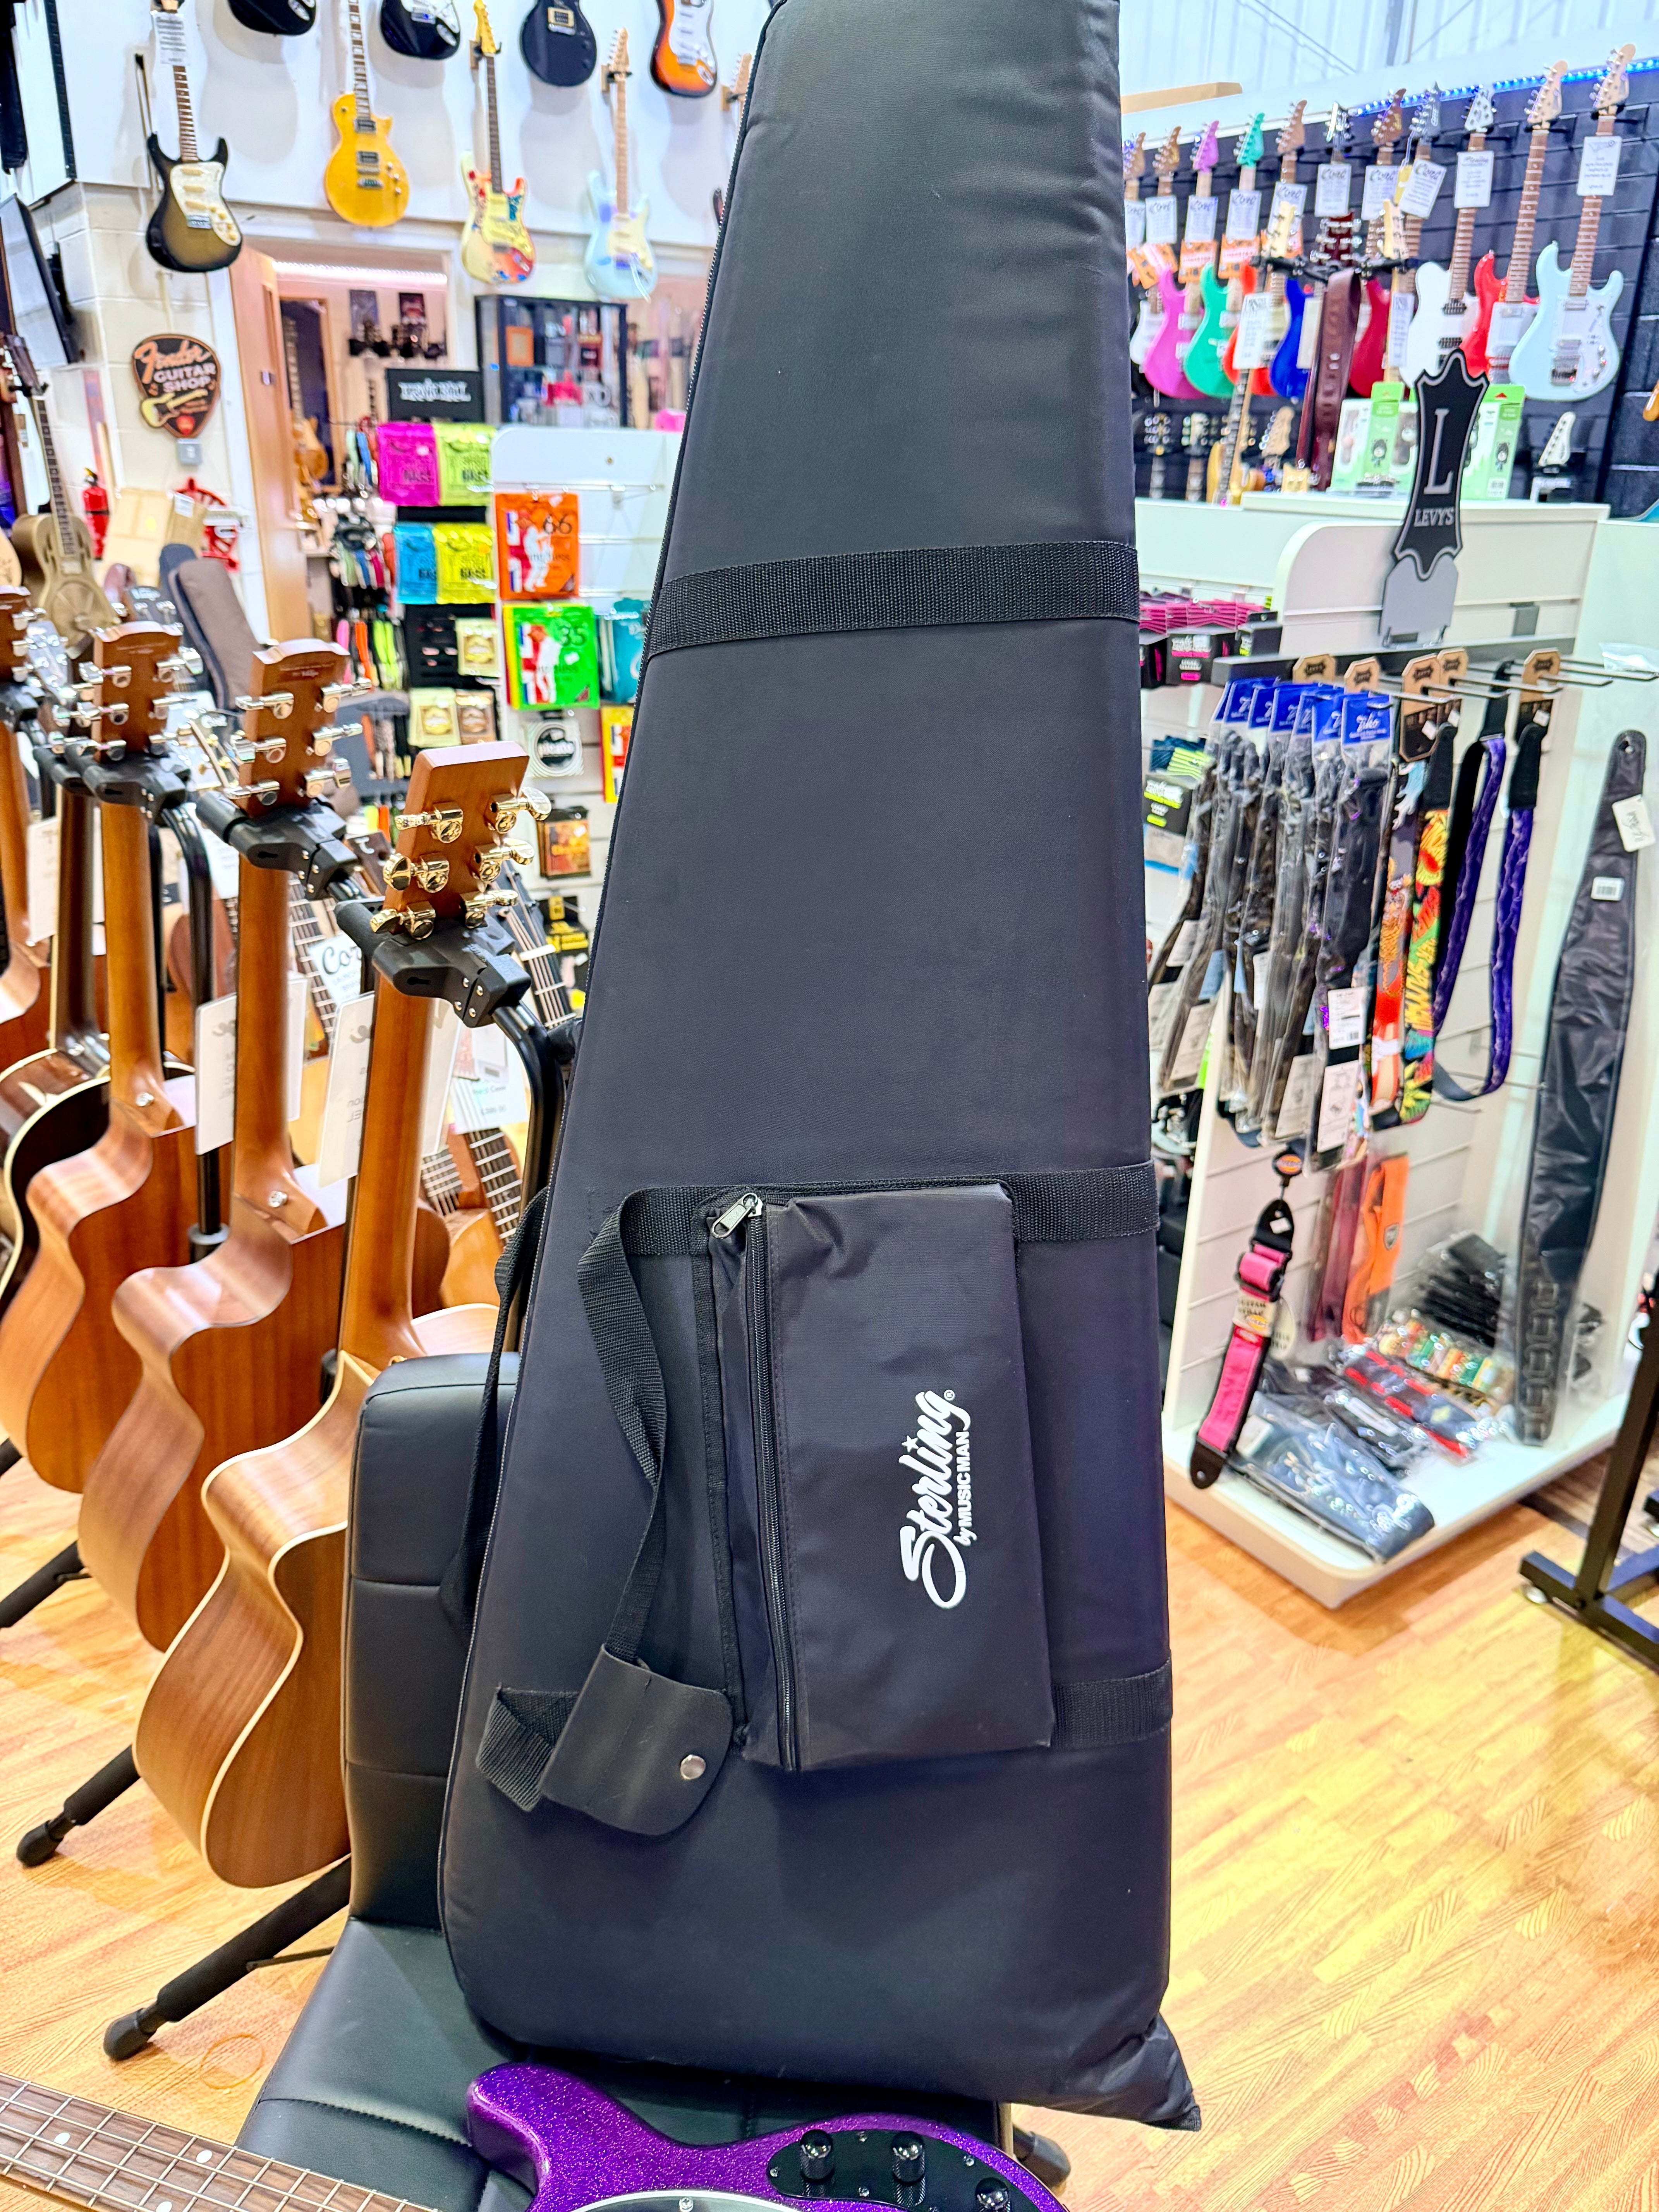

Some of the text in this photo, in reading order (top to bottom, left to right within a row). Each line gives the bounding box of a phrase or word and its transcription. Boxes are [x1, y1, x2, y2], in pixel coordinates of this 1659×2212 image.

[134, 340, 211, 384] Fender
[153, 362, 216, 383] GUITAR
[163, 375, 211, 393] SHOP
[1424, 408, 1453, 495] L
[543, 513, 572, 534] 66
[560, 625, 586, 646] 35
[322, 945, 362, 975] Cor
[898, 1390, 971, 1609] Sterling
[953, 1431, 977, 1546] by MUSIC MAN
